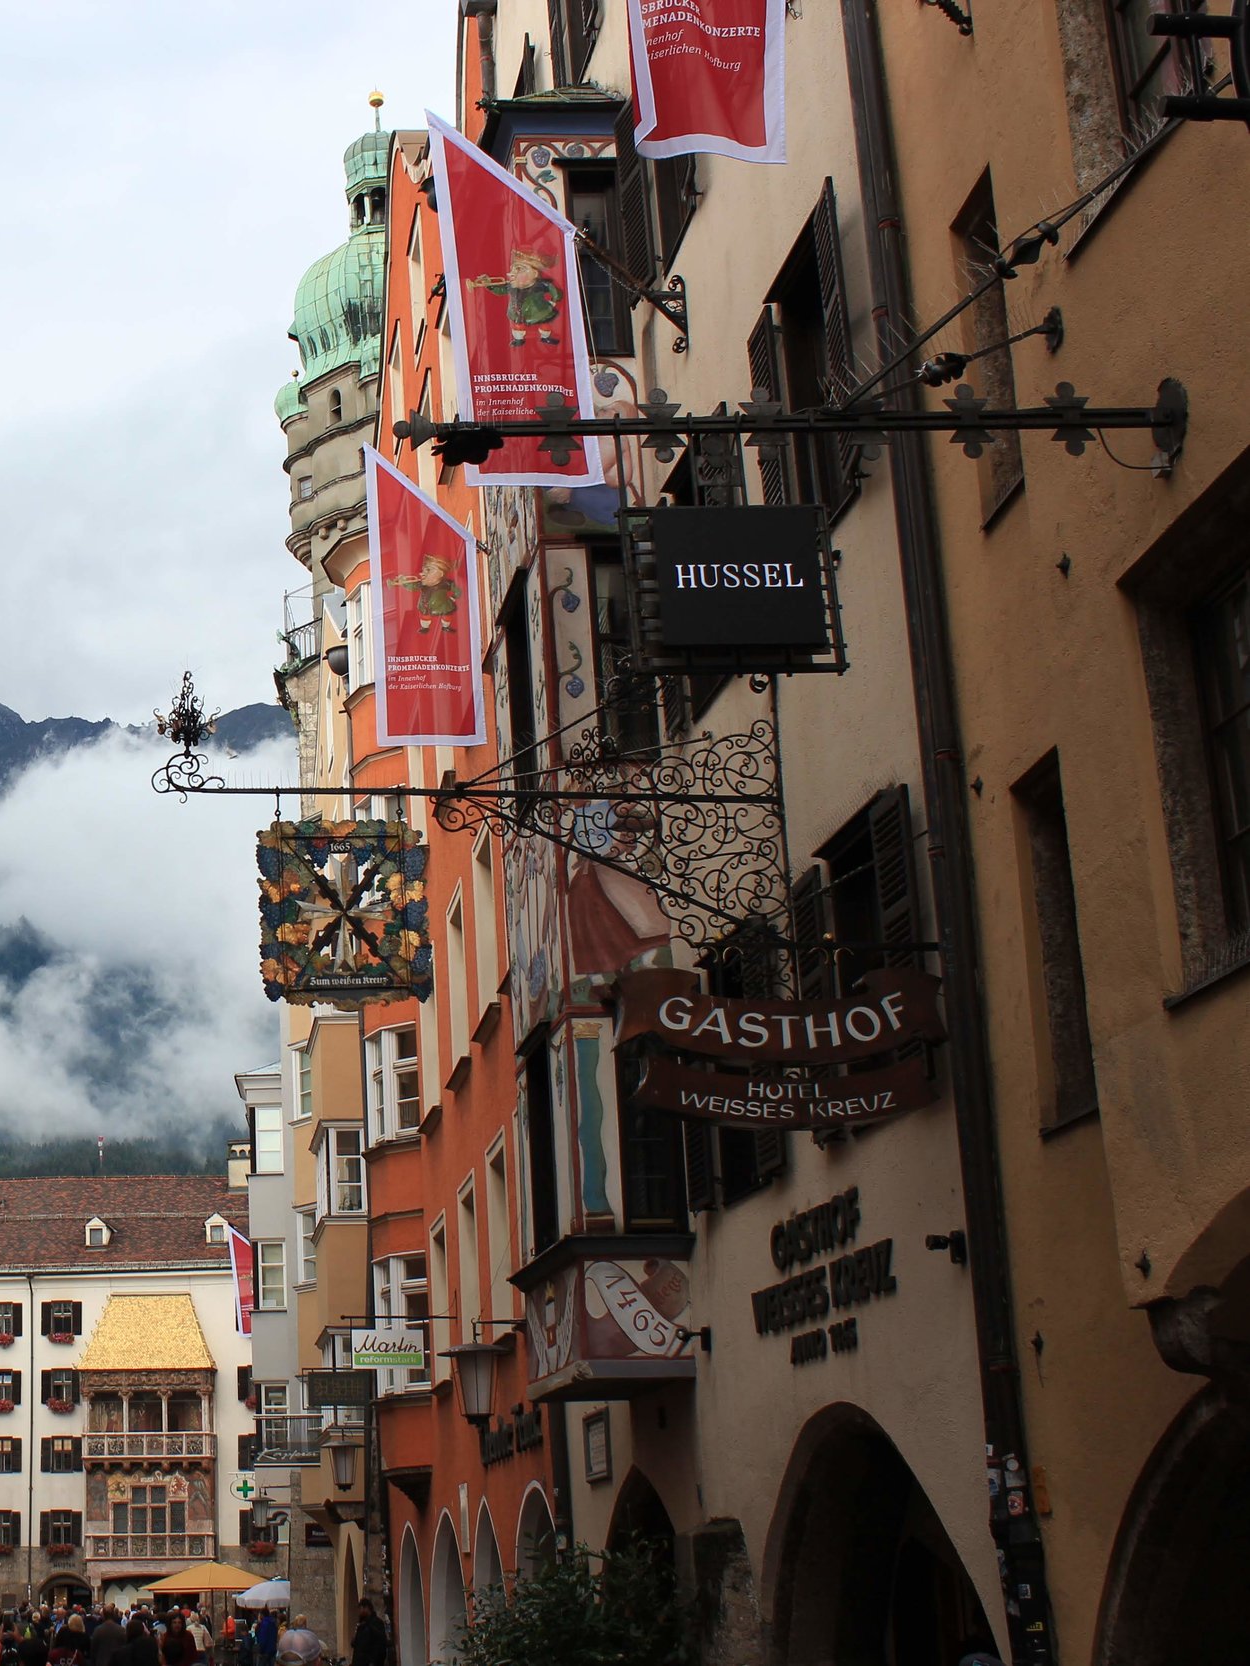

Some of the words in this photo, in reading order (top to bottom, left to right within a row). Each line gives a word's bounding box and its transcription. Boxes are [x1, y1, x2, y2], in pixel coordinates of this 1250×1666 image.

[704, 50, 741, 72] Hofburg
[474, 374, 537, 382] INNSBRUCKER
[476, 398, 486, 407] im
[488, 397, 525, 407] Innenhof
[477, 408, 489, 417] der
[675, 563, 804, 589] HUSSEL
[387, 655, 438, 663] INNSBRUCKER
[388, 664, 470, 672] PROMENADENKONZERTE
[398, 674, 426, 682] Innenhof
[438, 683, 462, 693] Hofburg
[658, 992, 905, 1050] GASTHOF
[747, 1082, 828, 1099] HOTEL
[681, 1090, 796, 1119] WEISSES
[809, 1091, 897, 1117] KREUZ
[770, 1186, 861, 1271] GASTHOF
[605, 1275, 669, 1346] 1465
[354, 1334, 422, 1353] Martin
[359, 1356, 417, 1364] reformstark
